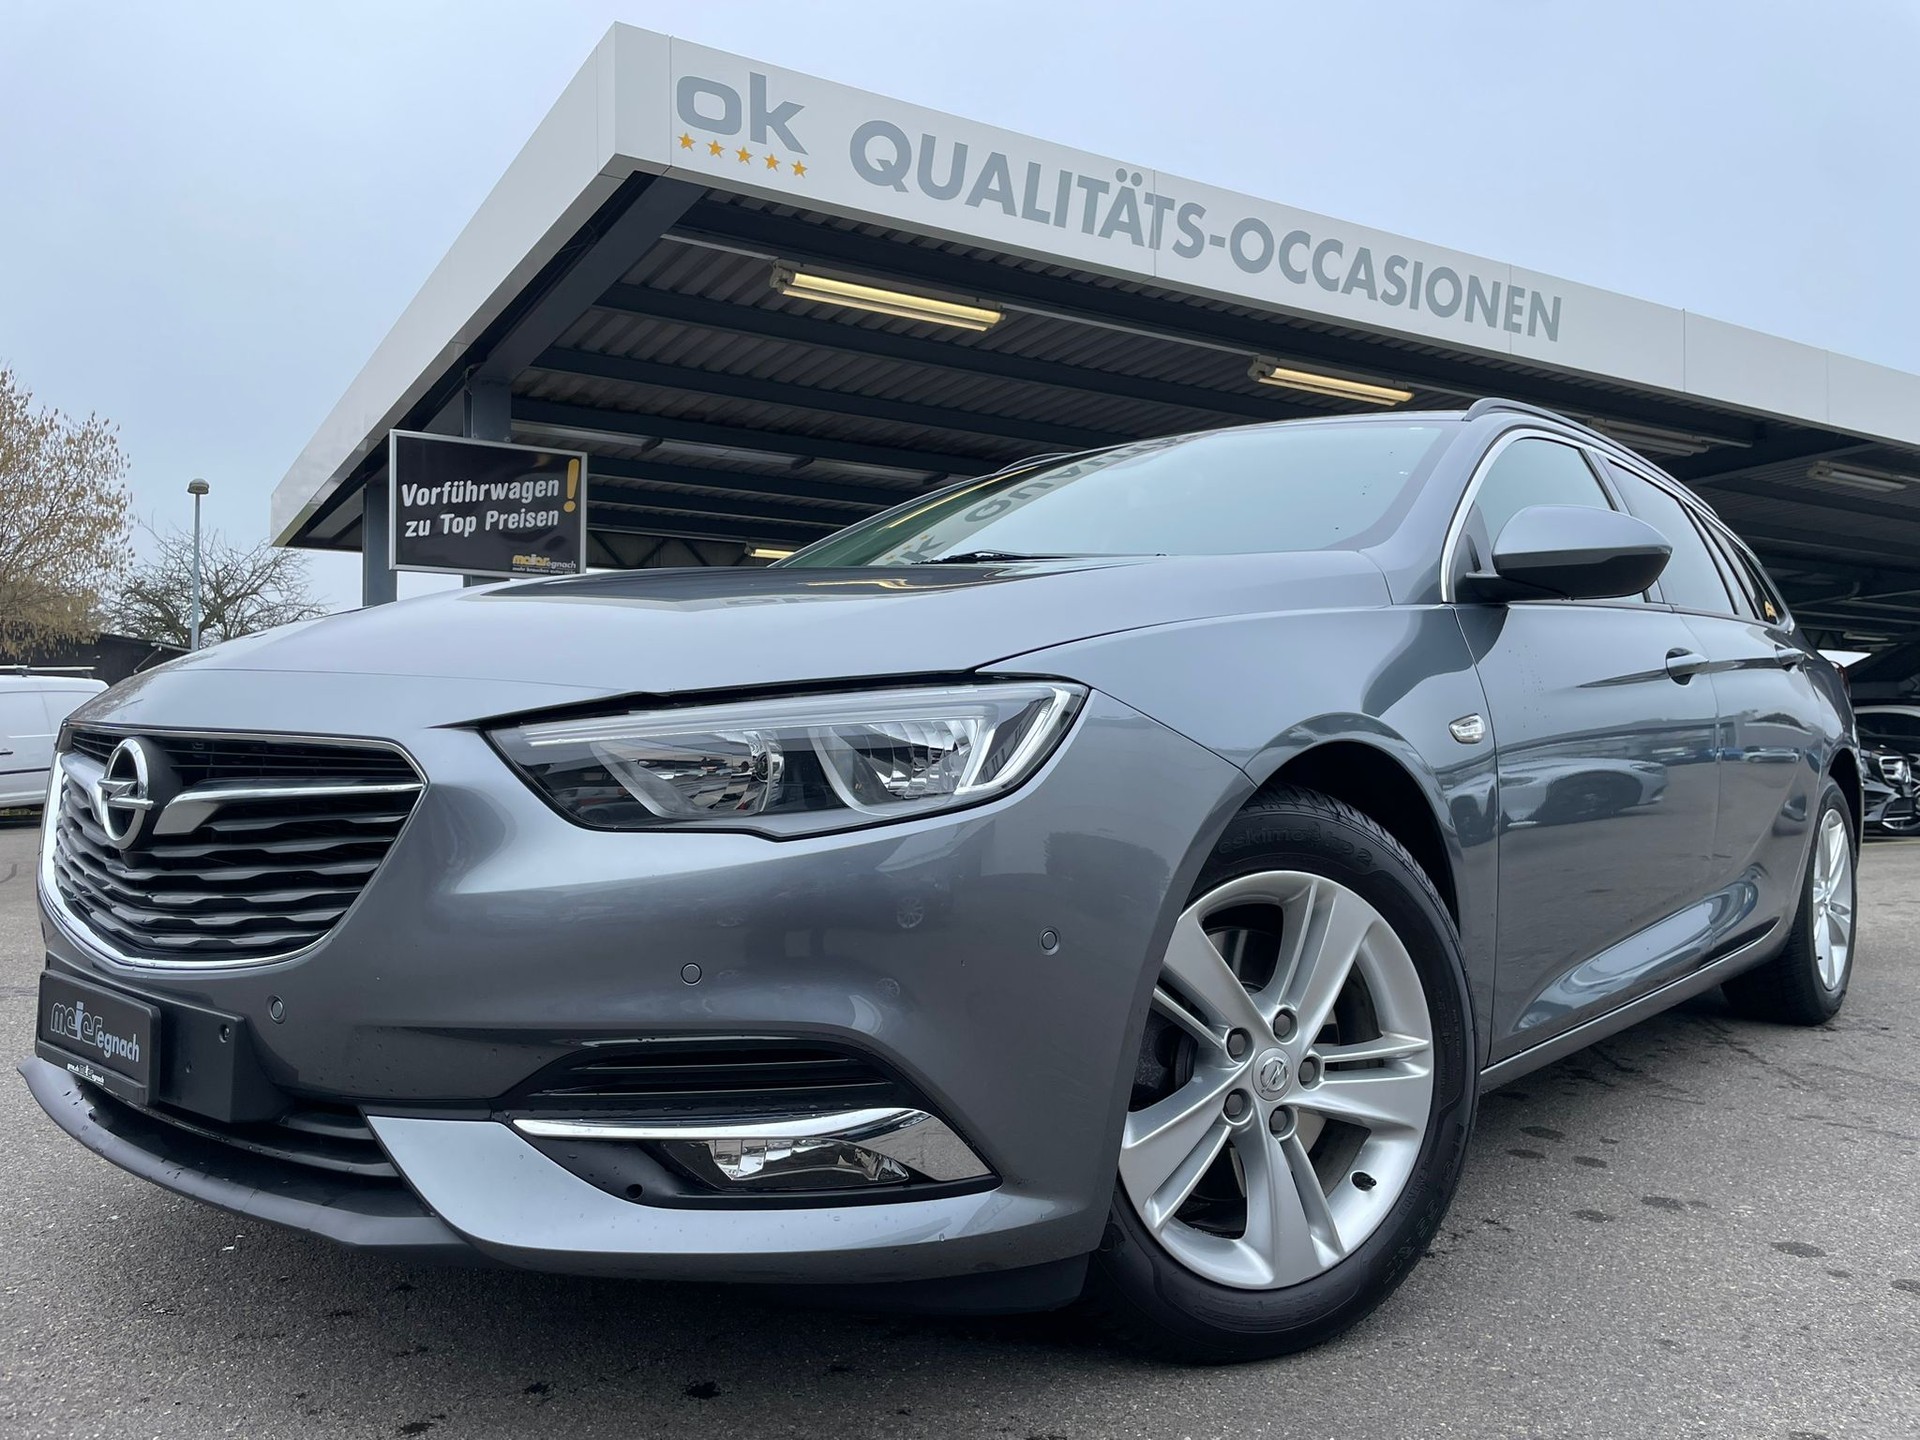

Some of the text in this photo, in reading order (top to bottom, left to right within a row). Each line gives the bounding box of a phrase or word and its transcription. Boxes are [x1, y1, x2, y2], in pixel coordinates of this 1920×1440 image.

[676, 71, 1562, 342] ok QUALITÄTS-OCCASIONEN
[401, 479, 560, 507] Vorführwagen
[405, 508, 559, 537] zu Top Preisen
